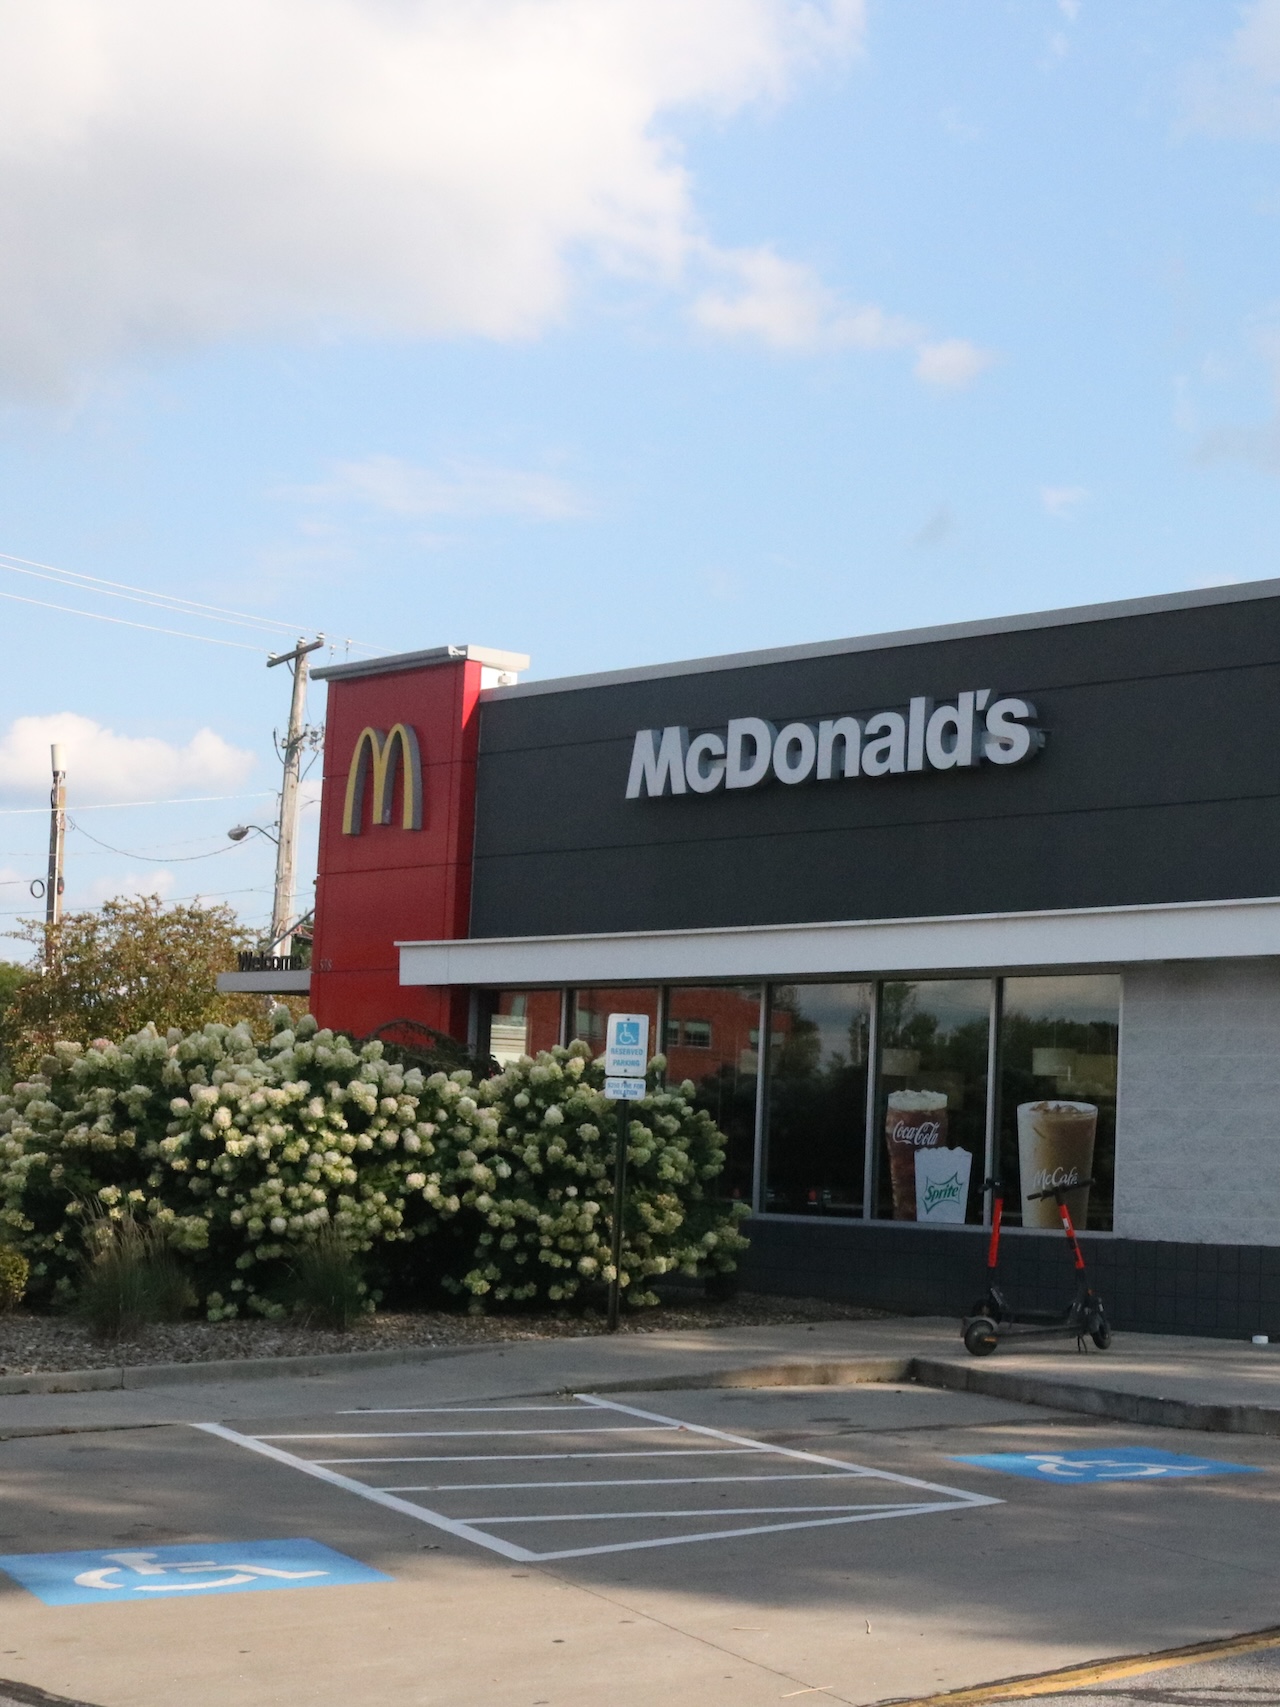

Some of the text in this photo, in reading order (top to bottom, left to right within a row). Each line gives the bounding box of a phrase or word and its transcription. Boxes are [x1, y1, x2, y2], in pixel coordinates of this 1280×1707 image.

[625, 688, 1036, 800] McDonald's
[238, 951, 303, 972] Welcome
[611, 1047, 643, 1056] RESERVED
[612, 1059, 640, 1067] PARKING
[892, 1120, 940, 1146] Coca-Cola
[1035, 1167, 1078, 1188] McCafé
[925, 1184, 960, 1201] Sprite
